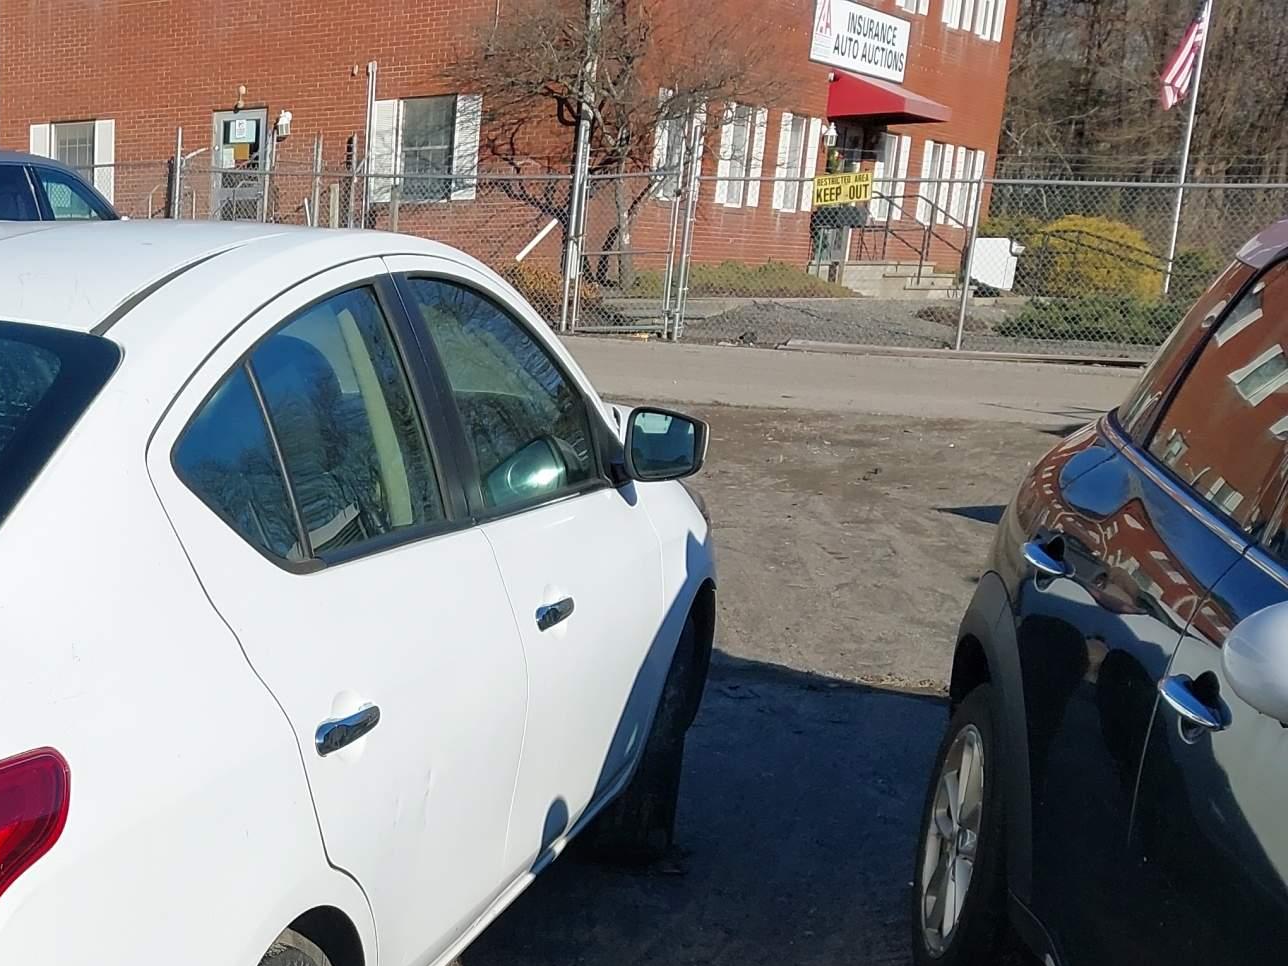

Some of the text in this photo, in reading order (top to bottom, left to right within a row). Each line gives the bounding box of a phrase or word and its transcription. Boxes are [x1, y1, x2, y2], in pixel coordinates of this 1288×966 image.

[847, 11, 898, 47] INSURANCE
[833, 33, 860, 60] AUTO
[861, 42, 905, 73] AUCTIONS
[816, 184, 870, 203] KEEP OUT
[817, 173, 869, 187] RESTRICTED AREA
